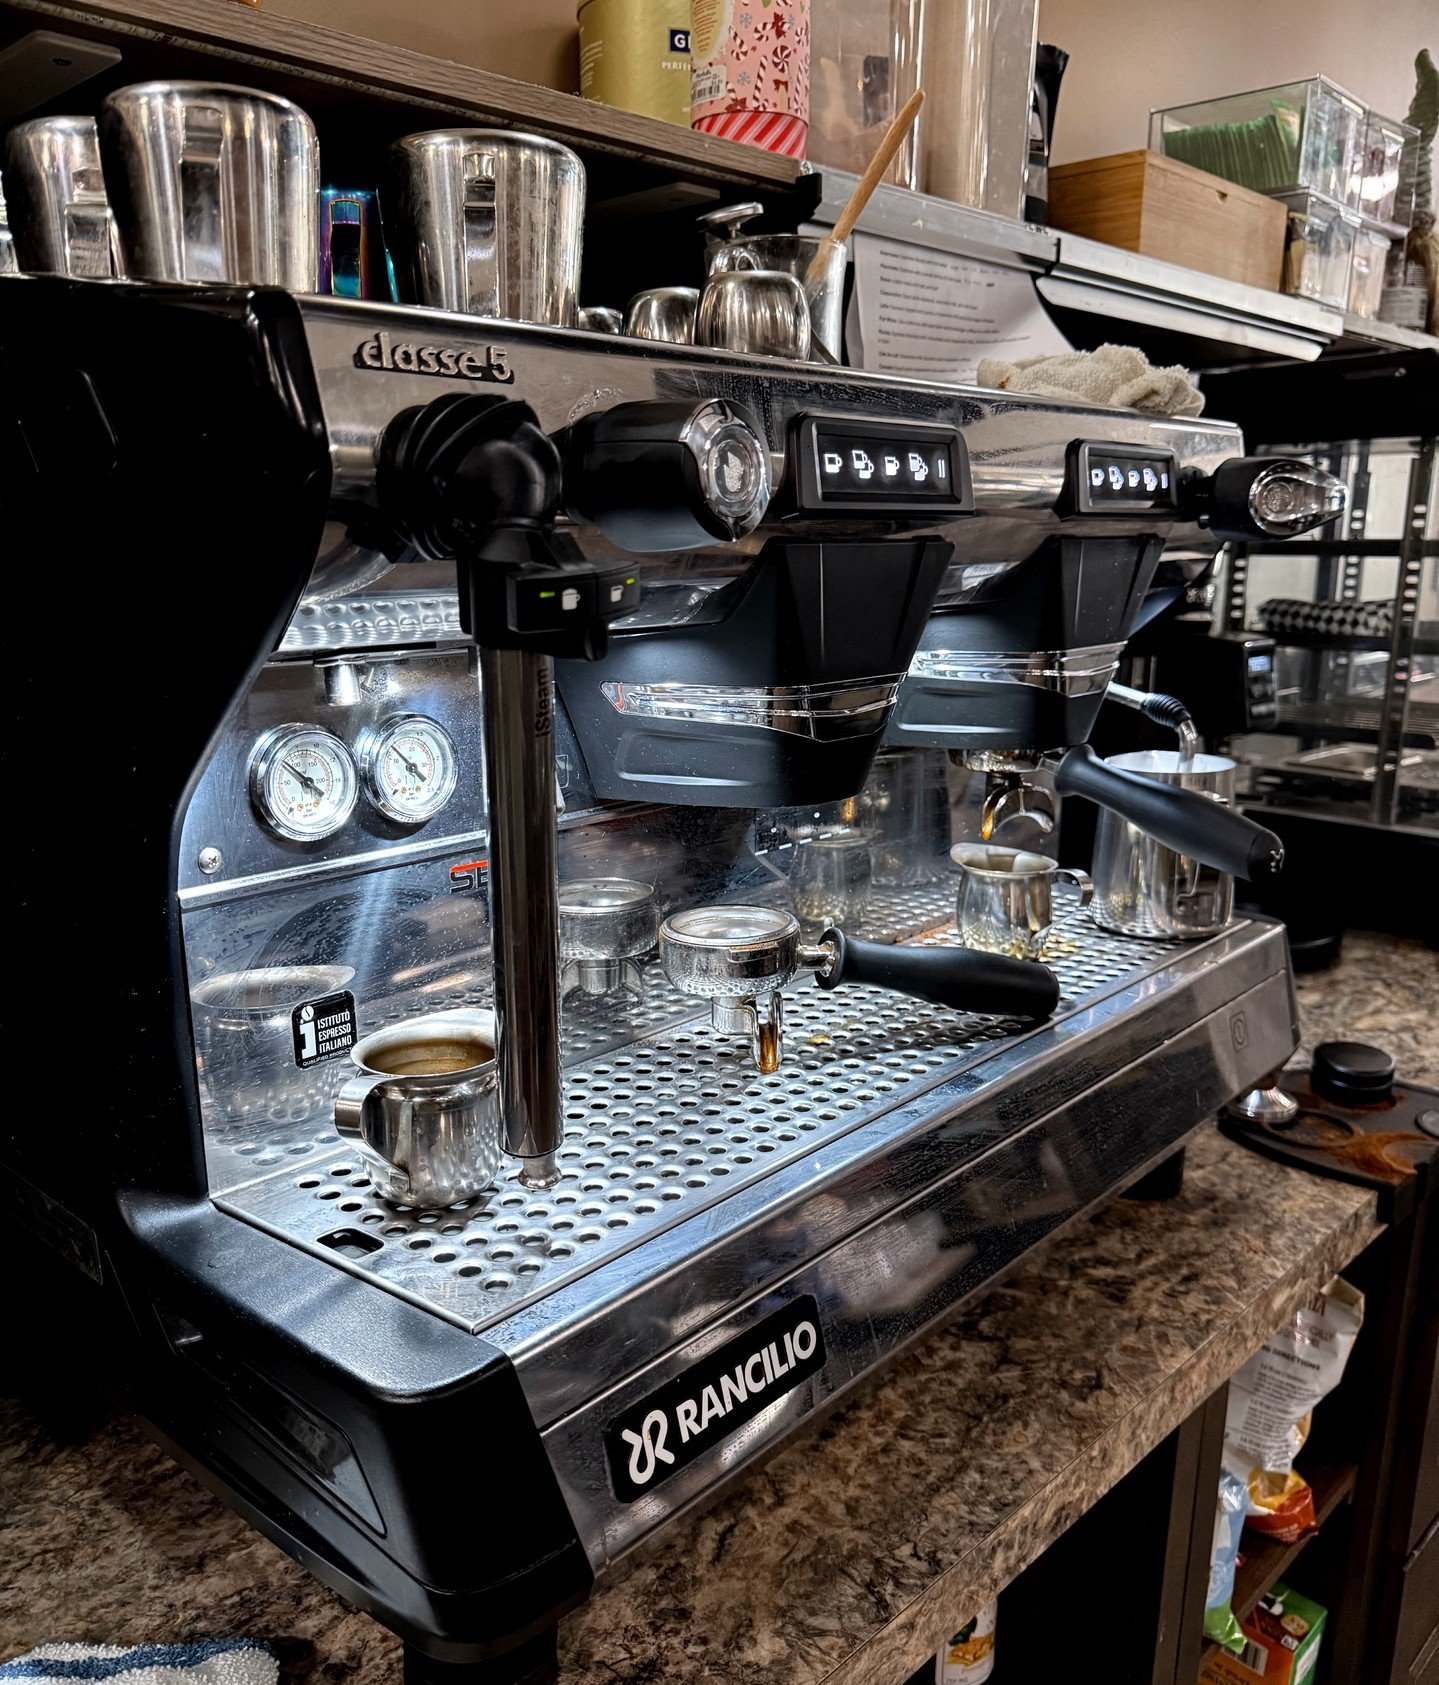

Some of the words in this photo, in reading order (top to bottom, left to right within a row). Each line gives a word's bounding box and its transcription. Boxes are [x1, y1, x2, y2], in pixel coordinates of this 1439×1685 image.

[535, 667, 551, 737] iSteam
[317, 1011, 350, 1029] ISTITUTO
[318, 1023, 351, 1041] ESPRESSO
[319, 1035, 352, 1054] ITALIANO
[302, 1055, 329, 1067] QUALIFIED
[675, 1321, 817, 1443] RANCILIO
